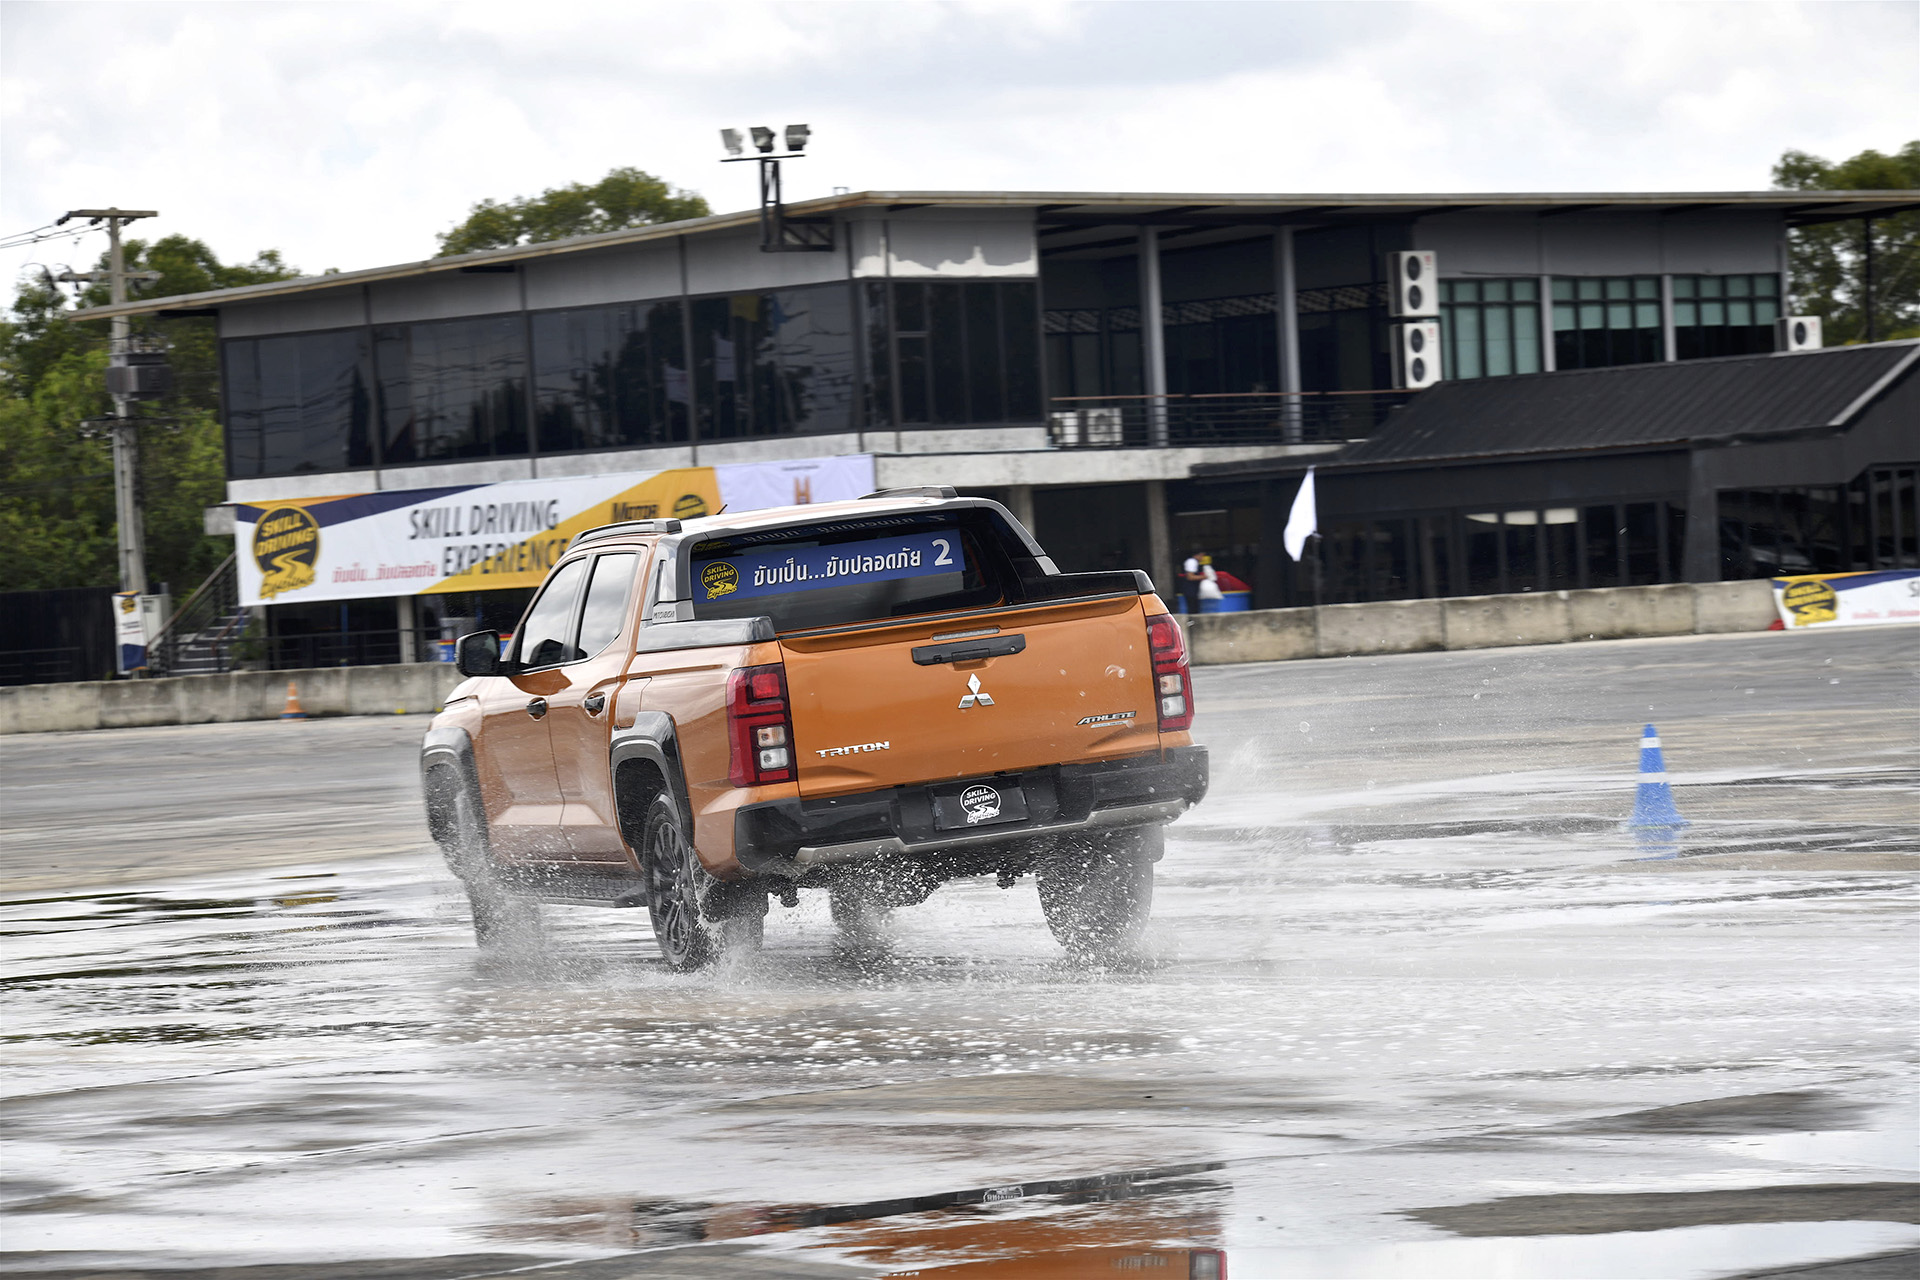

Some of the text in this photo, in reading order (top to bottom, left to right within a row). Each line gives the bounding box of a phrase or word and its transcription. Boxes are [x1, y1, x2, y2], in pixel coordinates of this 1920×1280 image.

[409, 499, 560, 540] SKILL DRIVING
[706, 564, 728, 576] SKILL
[753, 538, 953, 587] ขับเป็น...ขับปลอดภัย 2
[704, 569, 735, 583] DRIVING
[1076, 710, 1136, 726] ATHLETE
[815, 740, 890, 758] TRITON
[964, 792, 996, 806] DRIVING
[966, 788, 989, 799] SKILL
